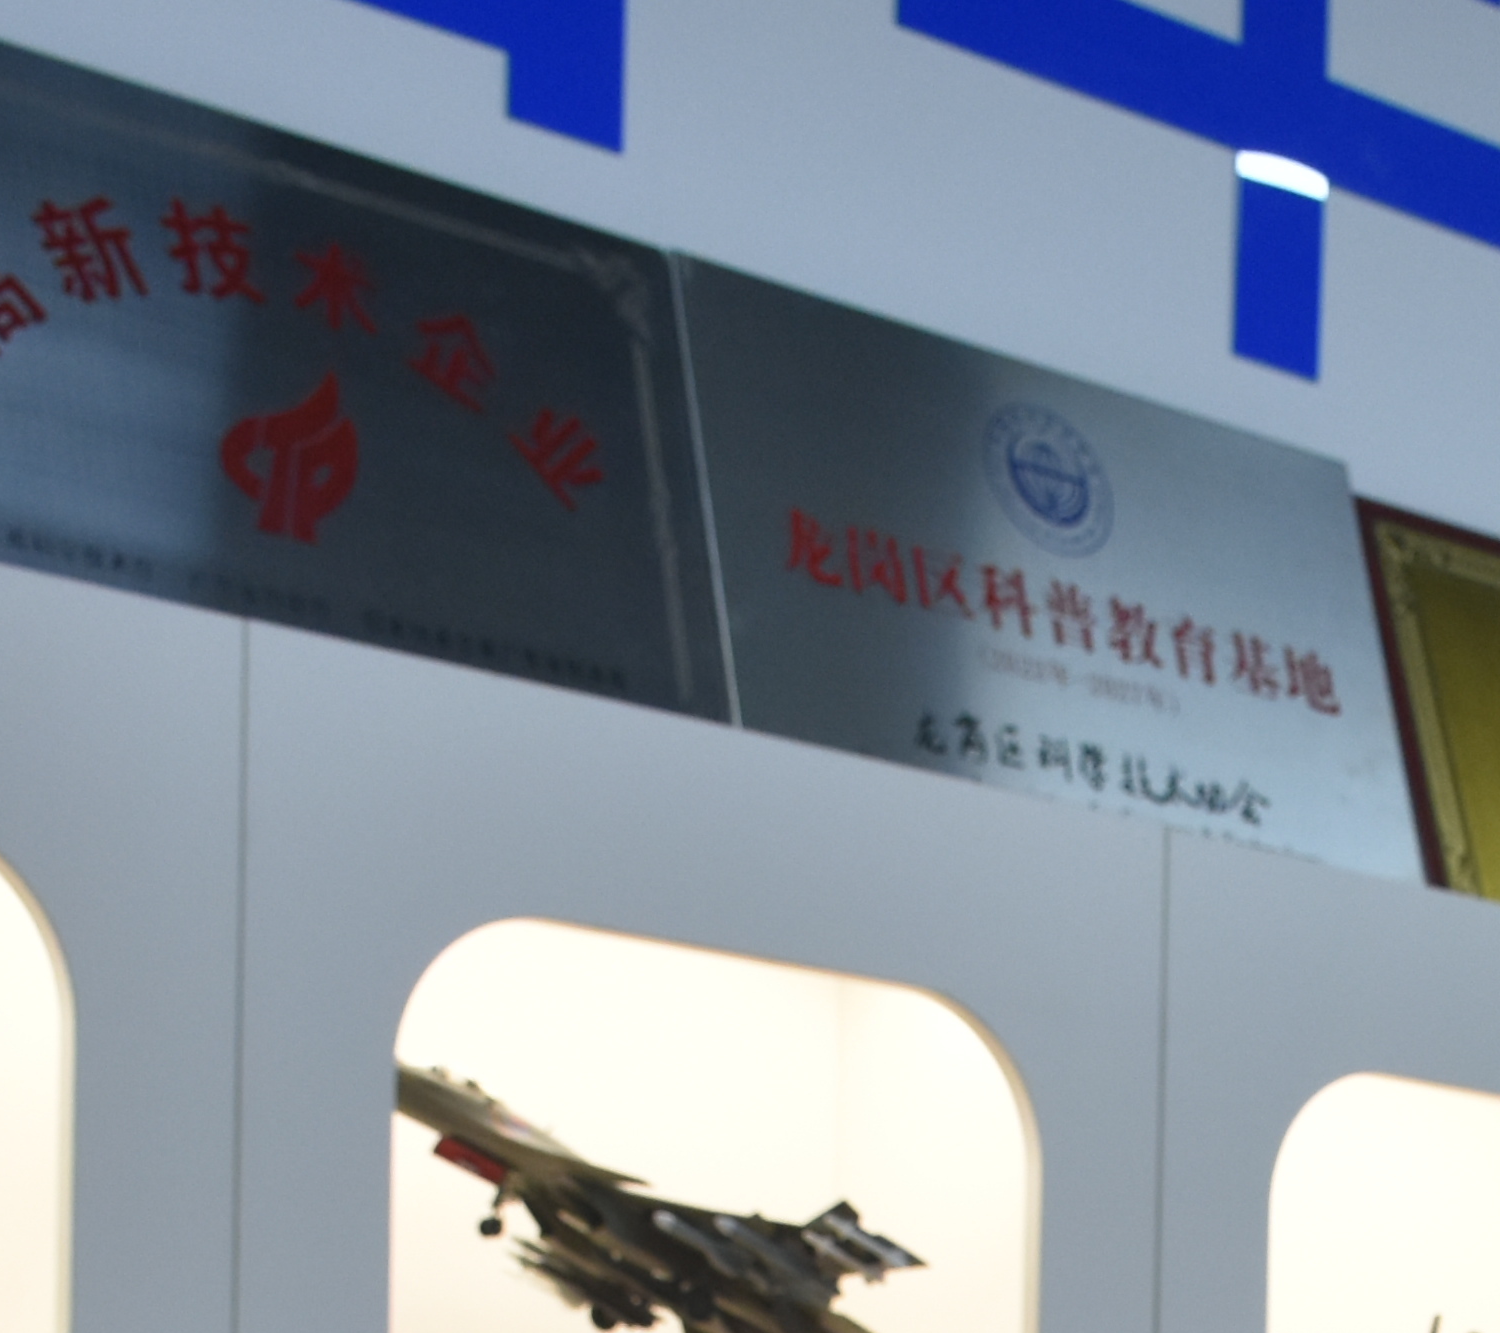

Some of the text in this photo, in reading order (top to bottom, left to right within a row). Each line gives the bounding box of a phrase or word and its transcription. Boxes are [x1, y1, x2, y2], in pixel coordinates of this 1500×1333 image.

[785, 505, 1343, 718] 龙岗区科普教育基地
